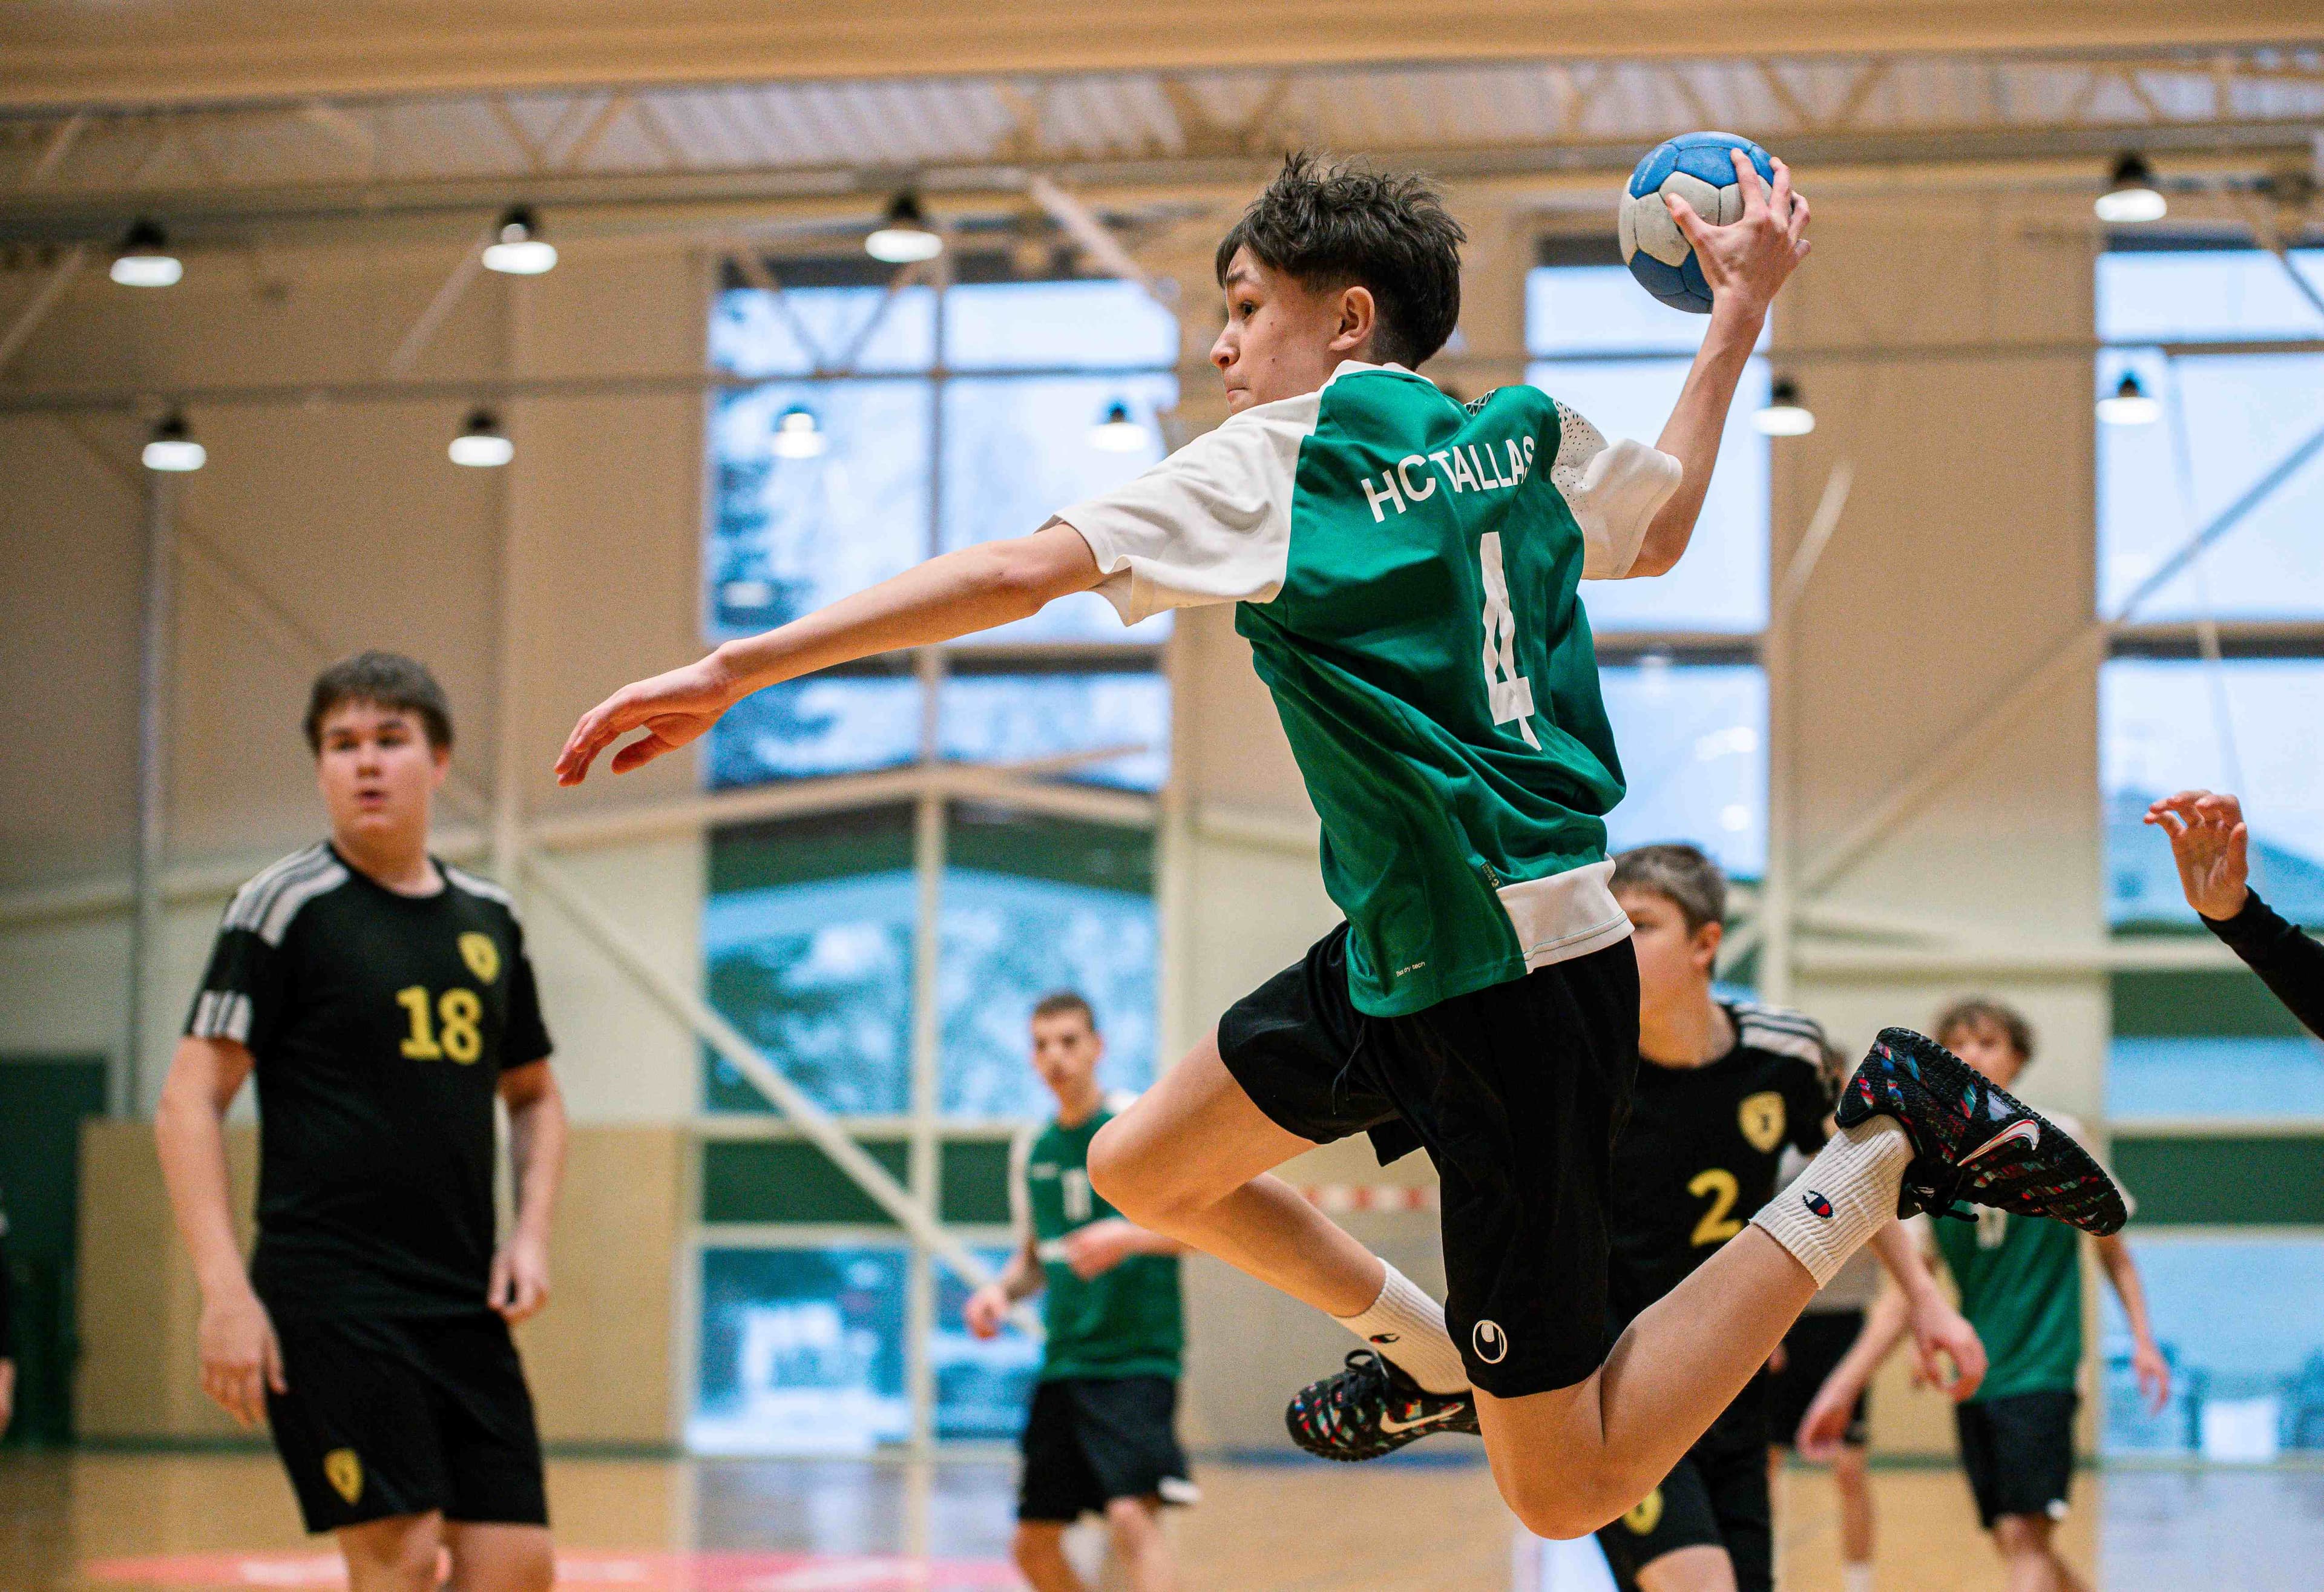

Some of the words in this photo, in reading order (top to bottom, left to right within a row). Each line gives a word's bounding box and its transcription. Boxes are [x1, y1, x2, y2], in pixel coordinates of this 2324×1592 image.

[1361, 454, 1436, 523] HC
[1480, 531, 1542, 751] 4
[395, 985, 484, 1065] 18
[1687, 1168, 1744, 1247] 2
